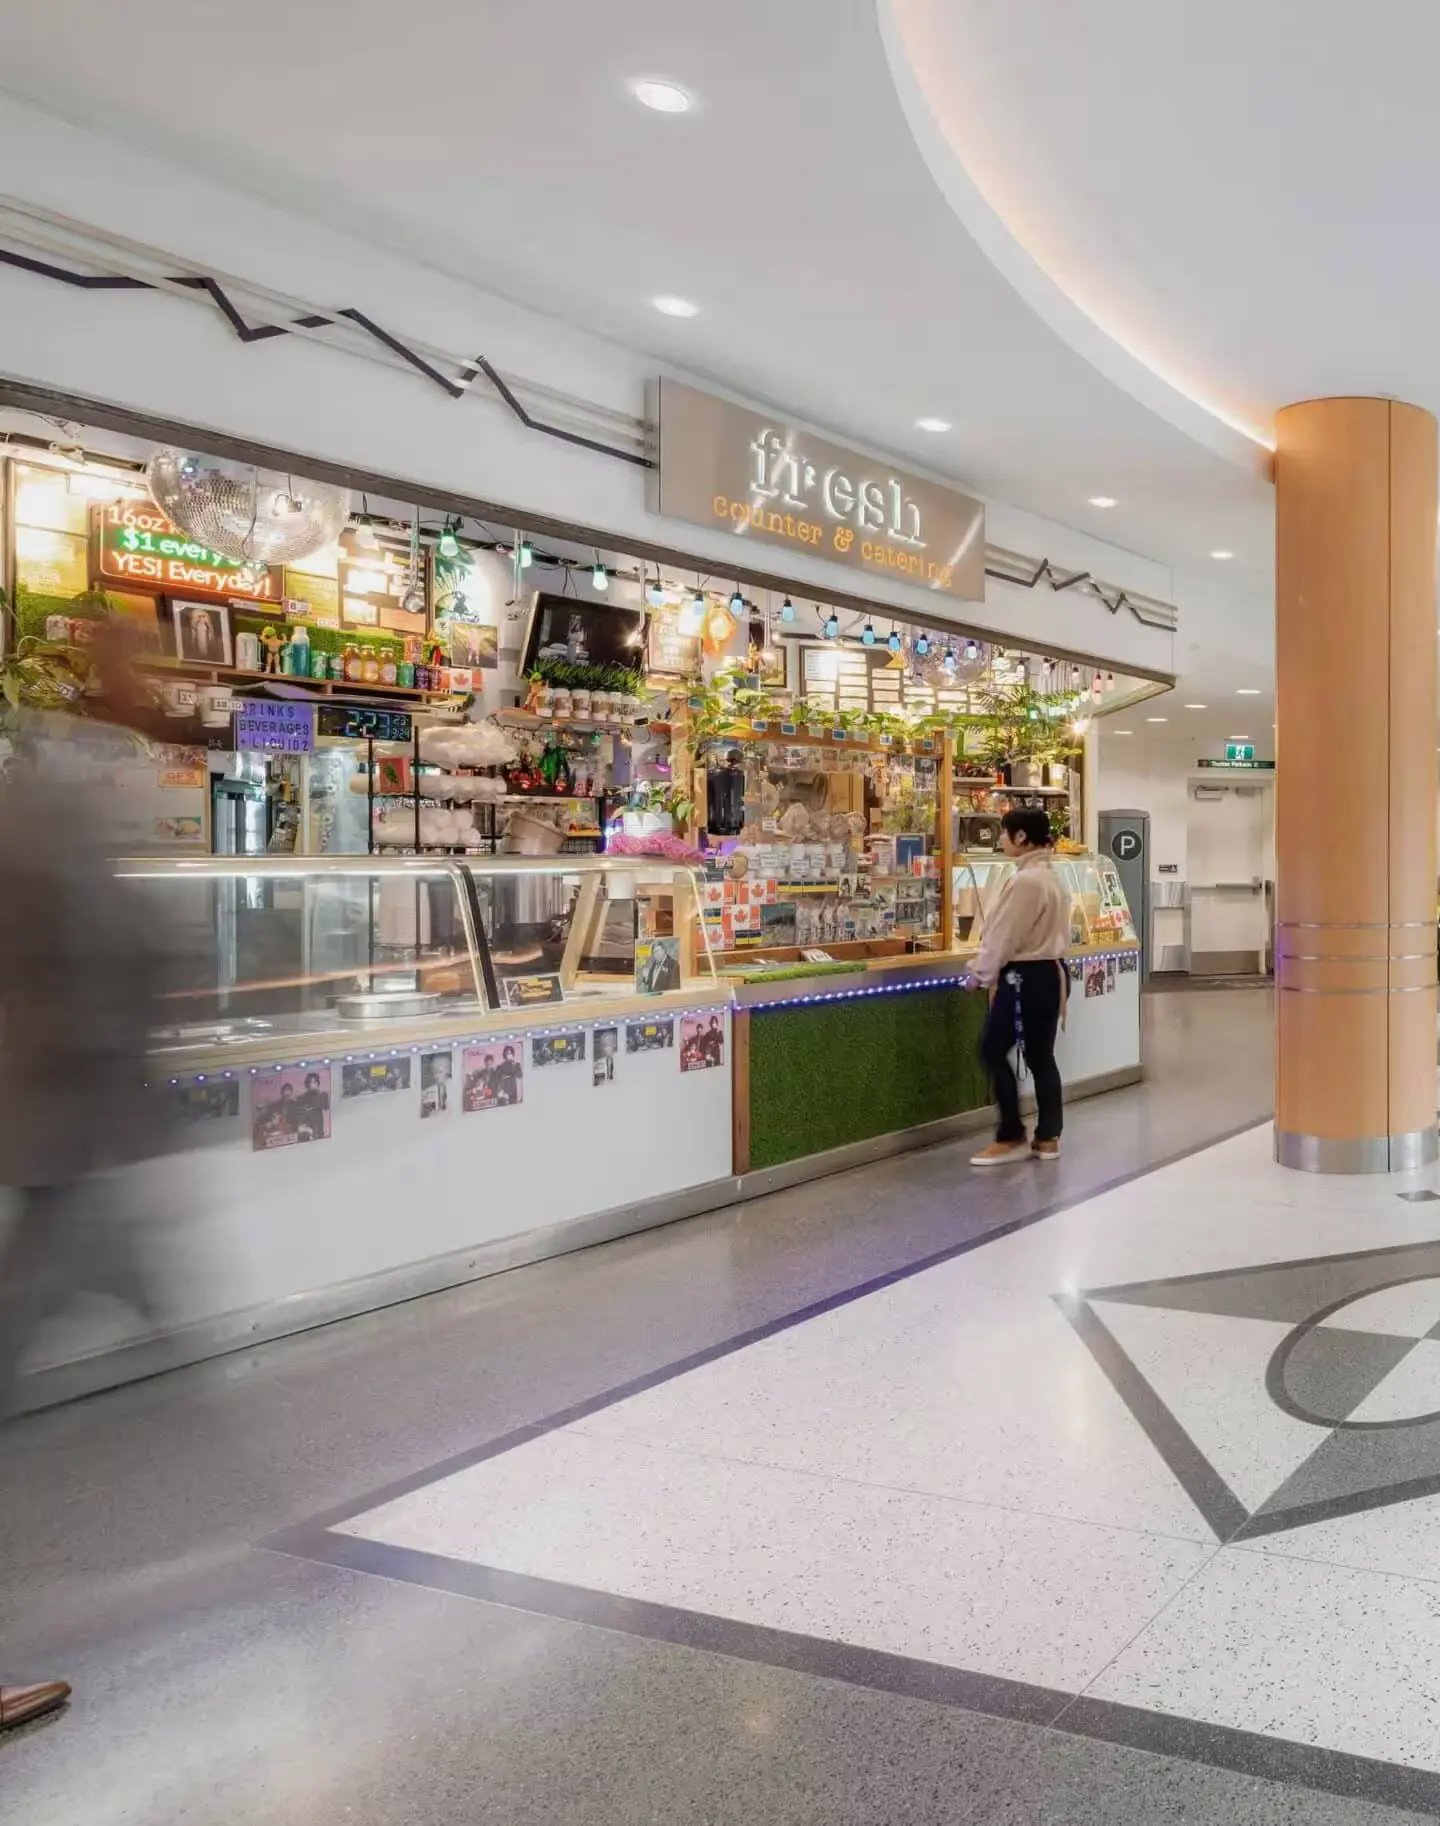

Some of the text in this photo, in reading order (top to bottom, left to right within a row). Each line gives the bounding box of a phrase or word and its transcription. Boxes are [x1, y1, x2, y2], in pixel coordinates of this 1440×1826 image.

[750, 427, 926, 547] fresh
[108, 505, 165, 532] 16oz
[123, 528, 155, 550] $1
[712, 496, 953, 587] counter & catering
[112, 551, 162, 578] YES!
[169, 560, 271, 597] Everyday!
[240, 703, 294, 717] DRINKS
[239, 720, 310, 736] BEVERAGES
[1120, 836, 1135, 856] P
